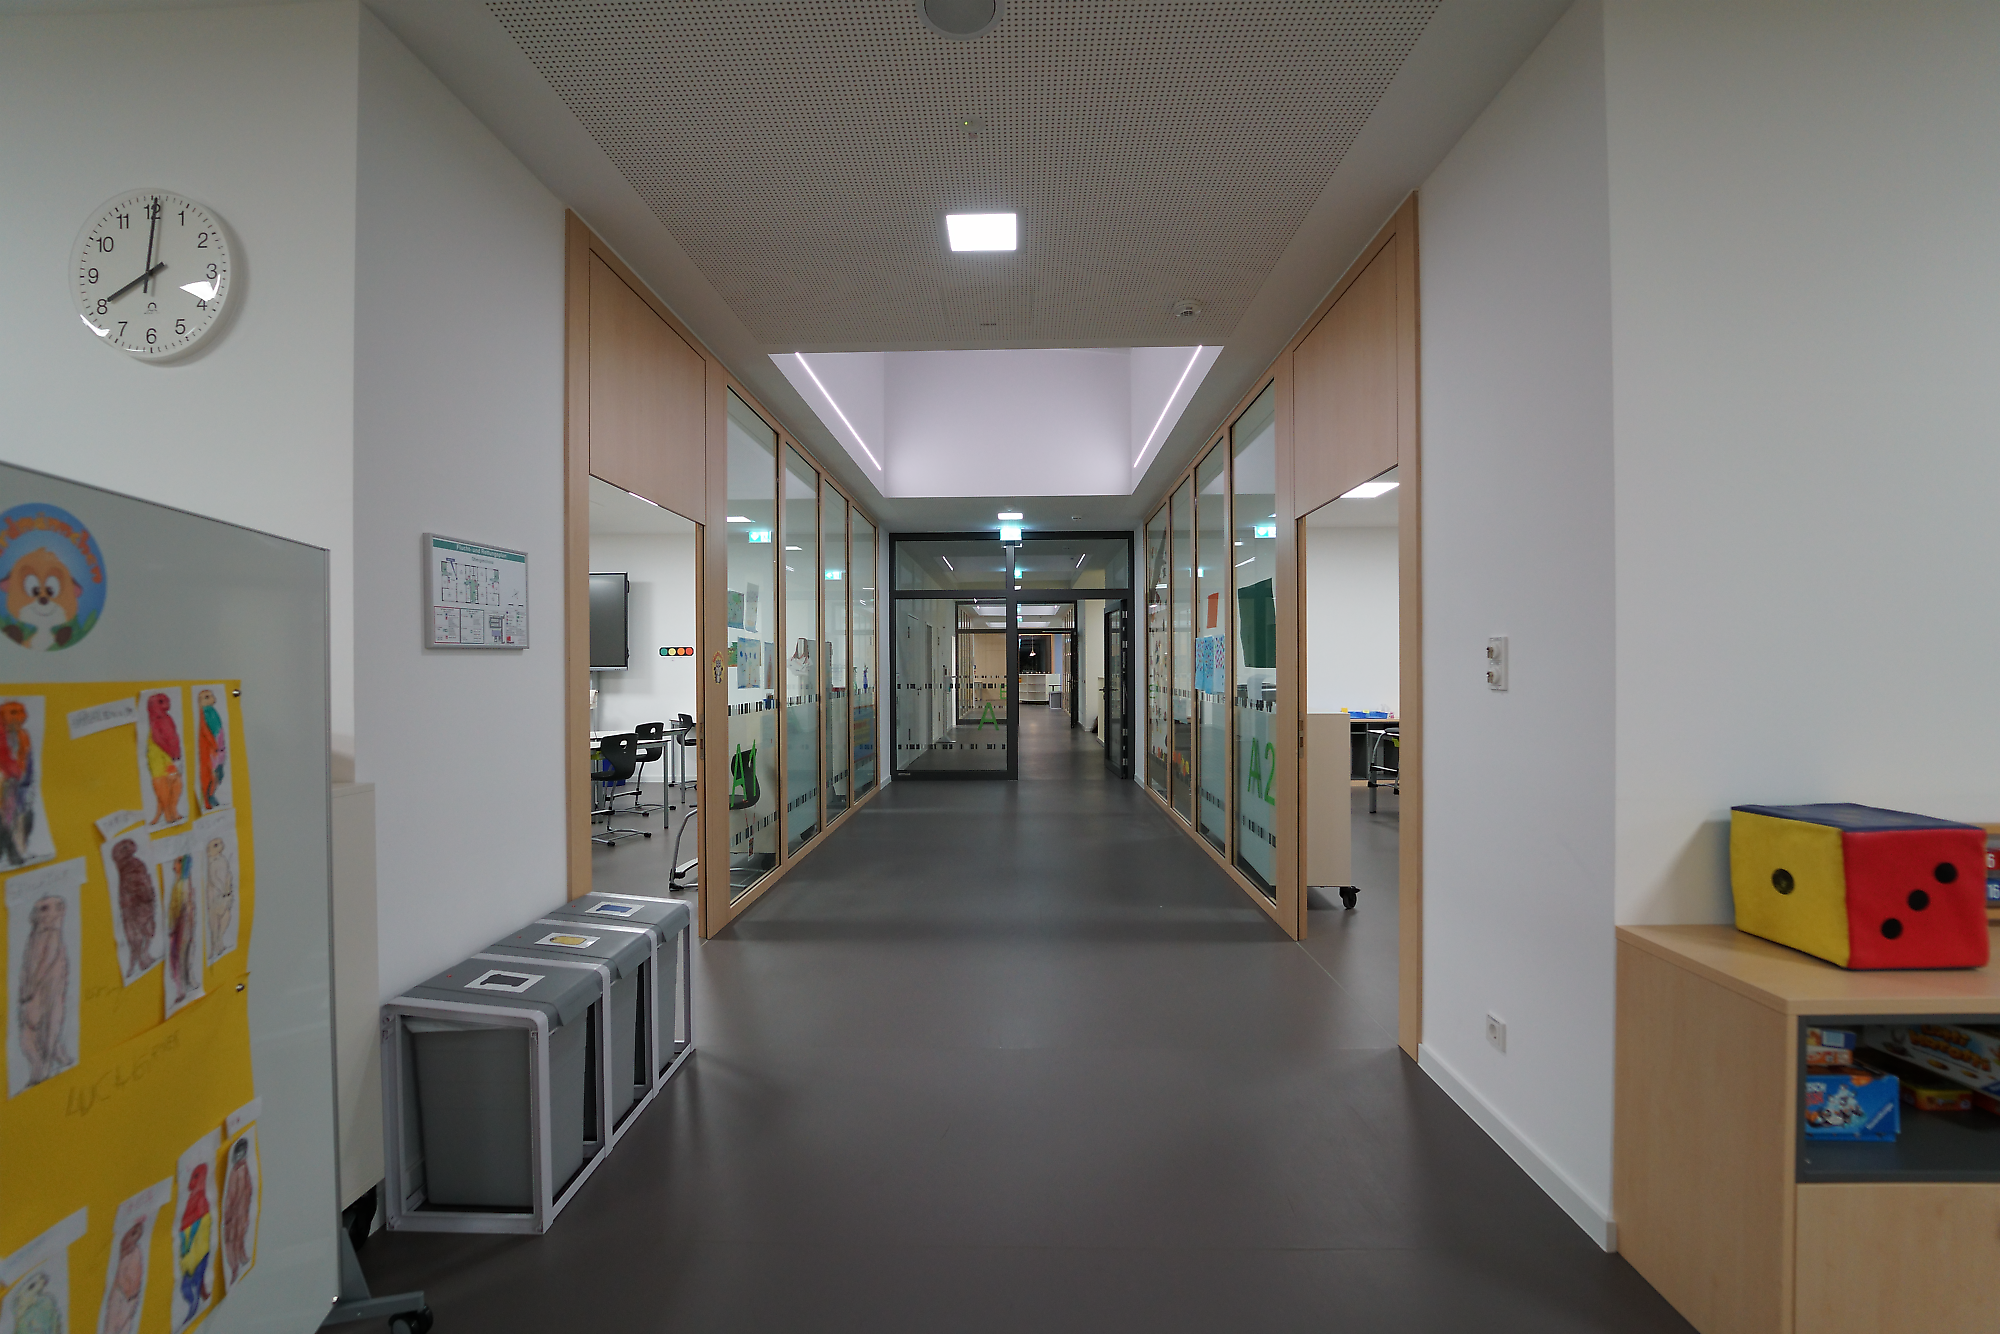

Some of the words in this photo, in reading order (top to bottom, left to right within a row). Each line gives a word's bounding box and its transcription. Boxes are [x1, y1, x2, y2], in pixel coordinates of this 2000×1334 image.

[143, 204, 161, 220] 12
[178, 210, 185, 226] 1
[116, 214, 129, 229] 11
[96, 236, 114, 252] 10
[197, 232, 208, 248] 2
[88, 268, 99, 284] 9
[206, 263, 217, 279] 3
[97, 298, 108, 315] 8
[196, 299, 207, 311] 4
[118, 321, 128, 337] 7
[175, 319, 186, 334] 5
[146, 328, 157, 344] 6
[977, 702, 1000, 731] A
[730, 739, 757, 808] A1
[1247, 737, 1276, 807] A2
